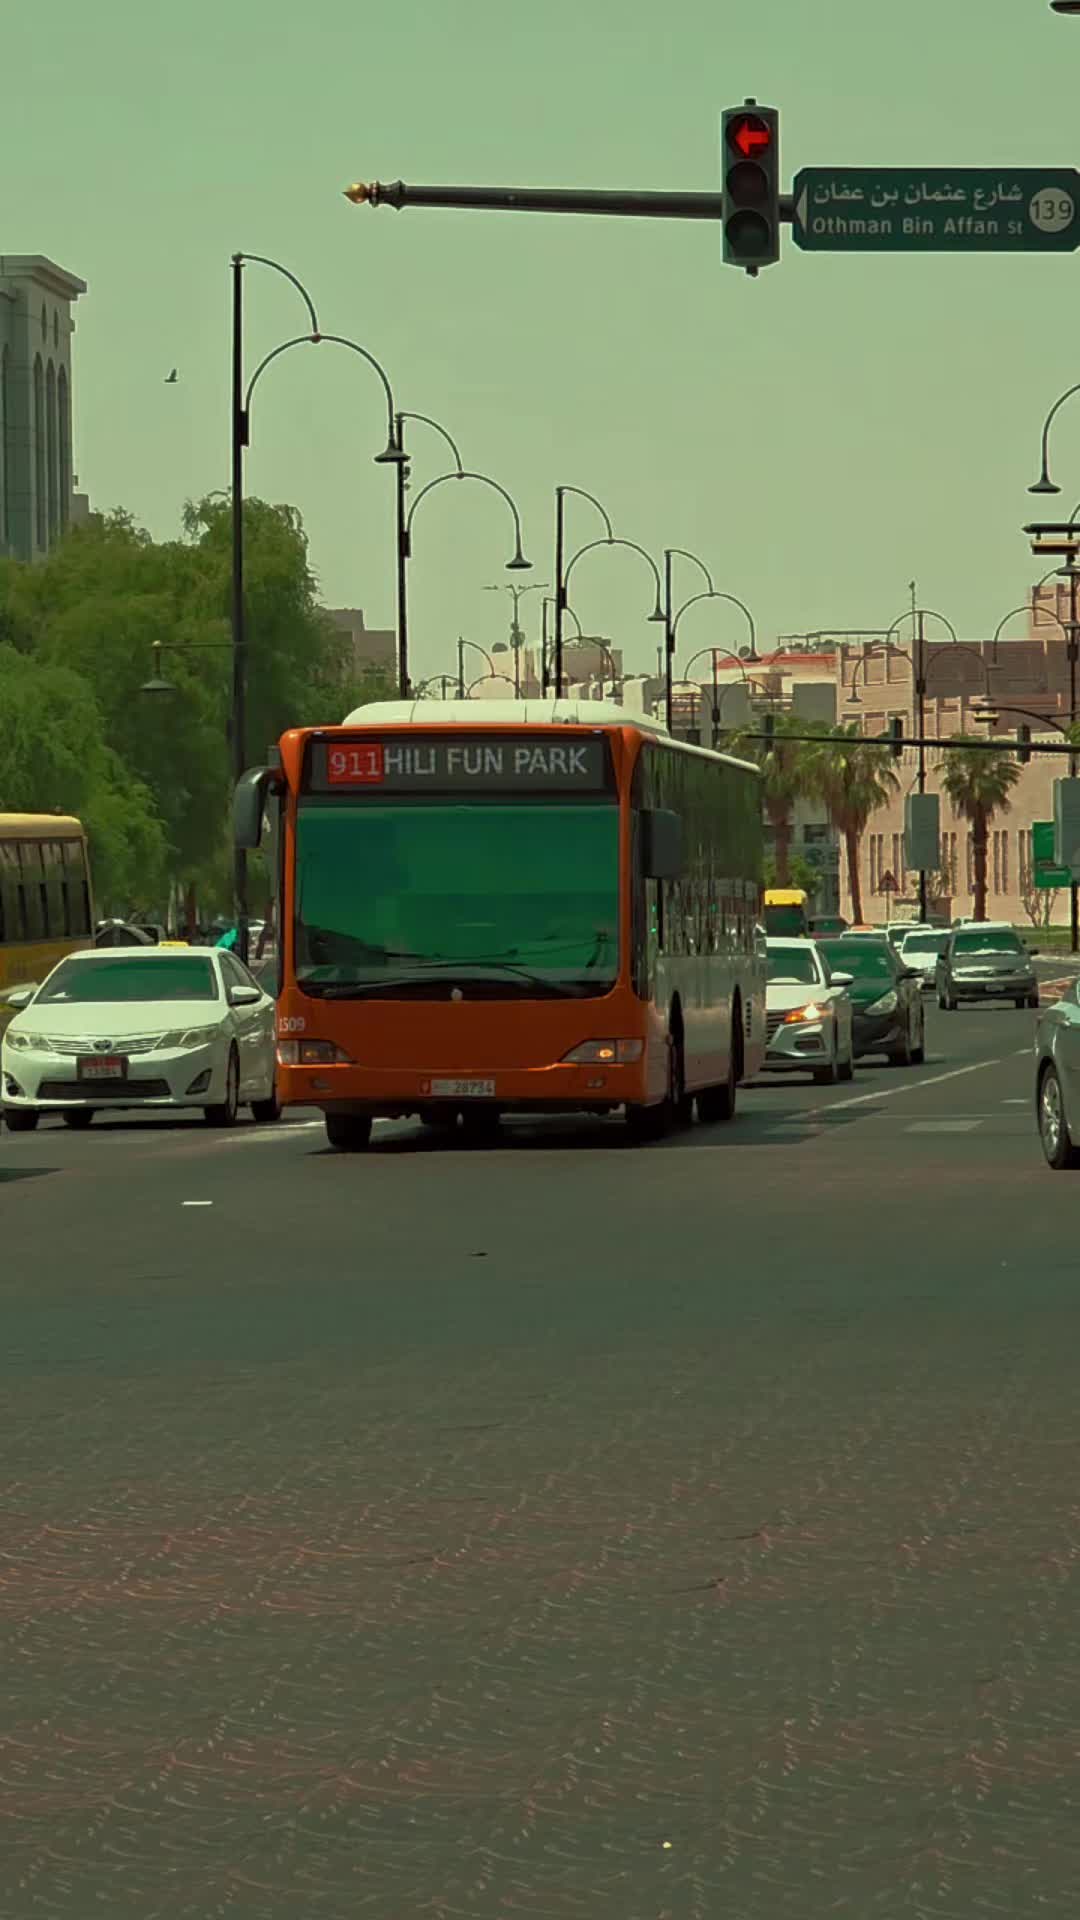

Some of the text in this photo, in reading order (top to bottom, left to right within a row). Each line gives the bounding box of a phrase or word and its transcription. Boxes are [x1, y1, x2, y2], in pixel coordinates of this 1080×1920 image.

[814, 182, 1024, 211] شارع عثمان بن عفان
[1031, 199, 1072, 220] 139
[812, 216, 892, 235] Othman
[902, 216, 934, 235] Bin
[943, 216, 999, 235] Affan
[329, 747, 587, 776] 911 HILI FUN PARK
